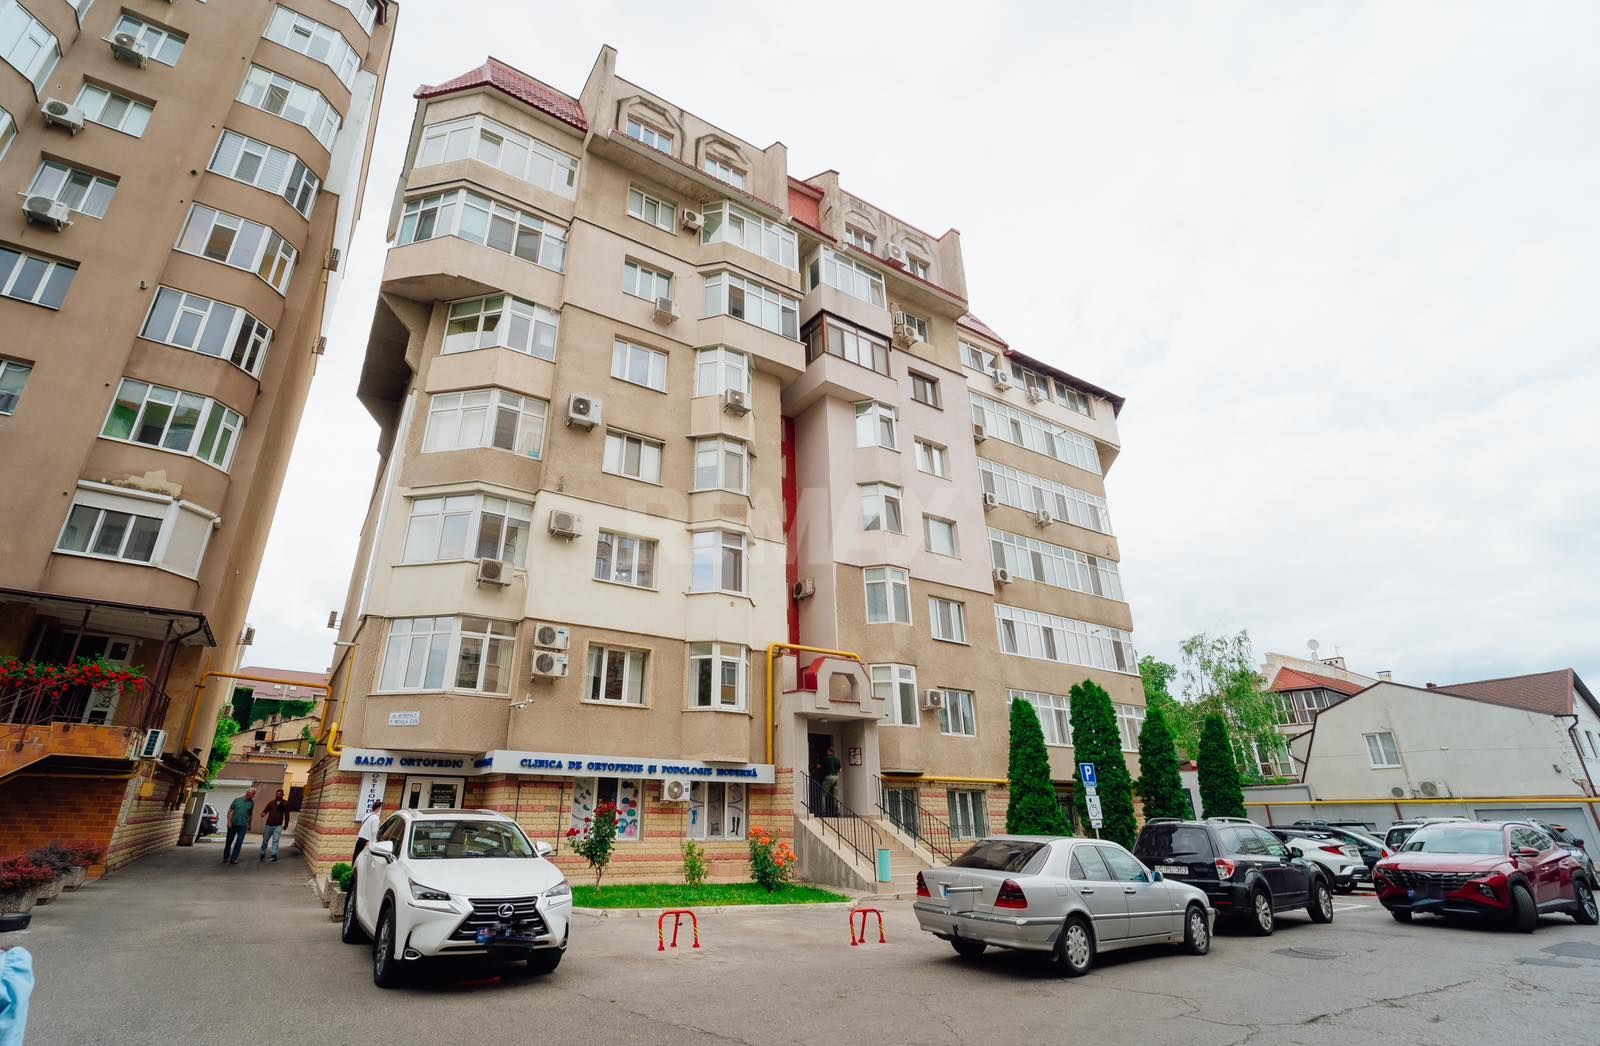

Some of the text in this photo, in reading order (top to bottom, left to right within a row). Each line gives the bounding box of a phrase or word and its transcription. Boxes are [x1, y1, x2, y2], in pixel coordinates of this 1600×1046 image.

[354, 755, 394, 767] SALON
[400, 757, 464, 768] ORTOPEDIC
[520, 758, 563, 769] CLINICA
[568, 760, 583, 770] DE
[587, 761, 644, 773] ORTOPEDIE
[661, 765, 713, 776] PODOLOGIE
[1084, 765, 1092, 780] P
[365, 773, 379, 814] OSTEOMED
